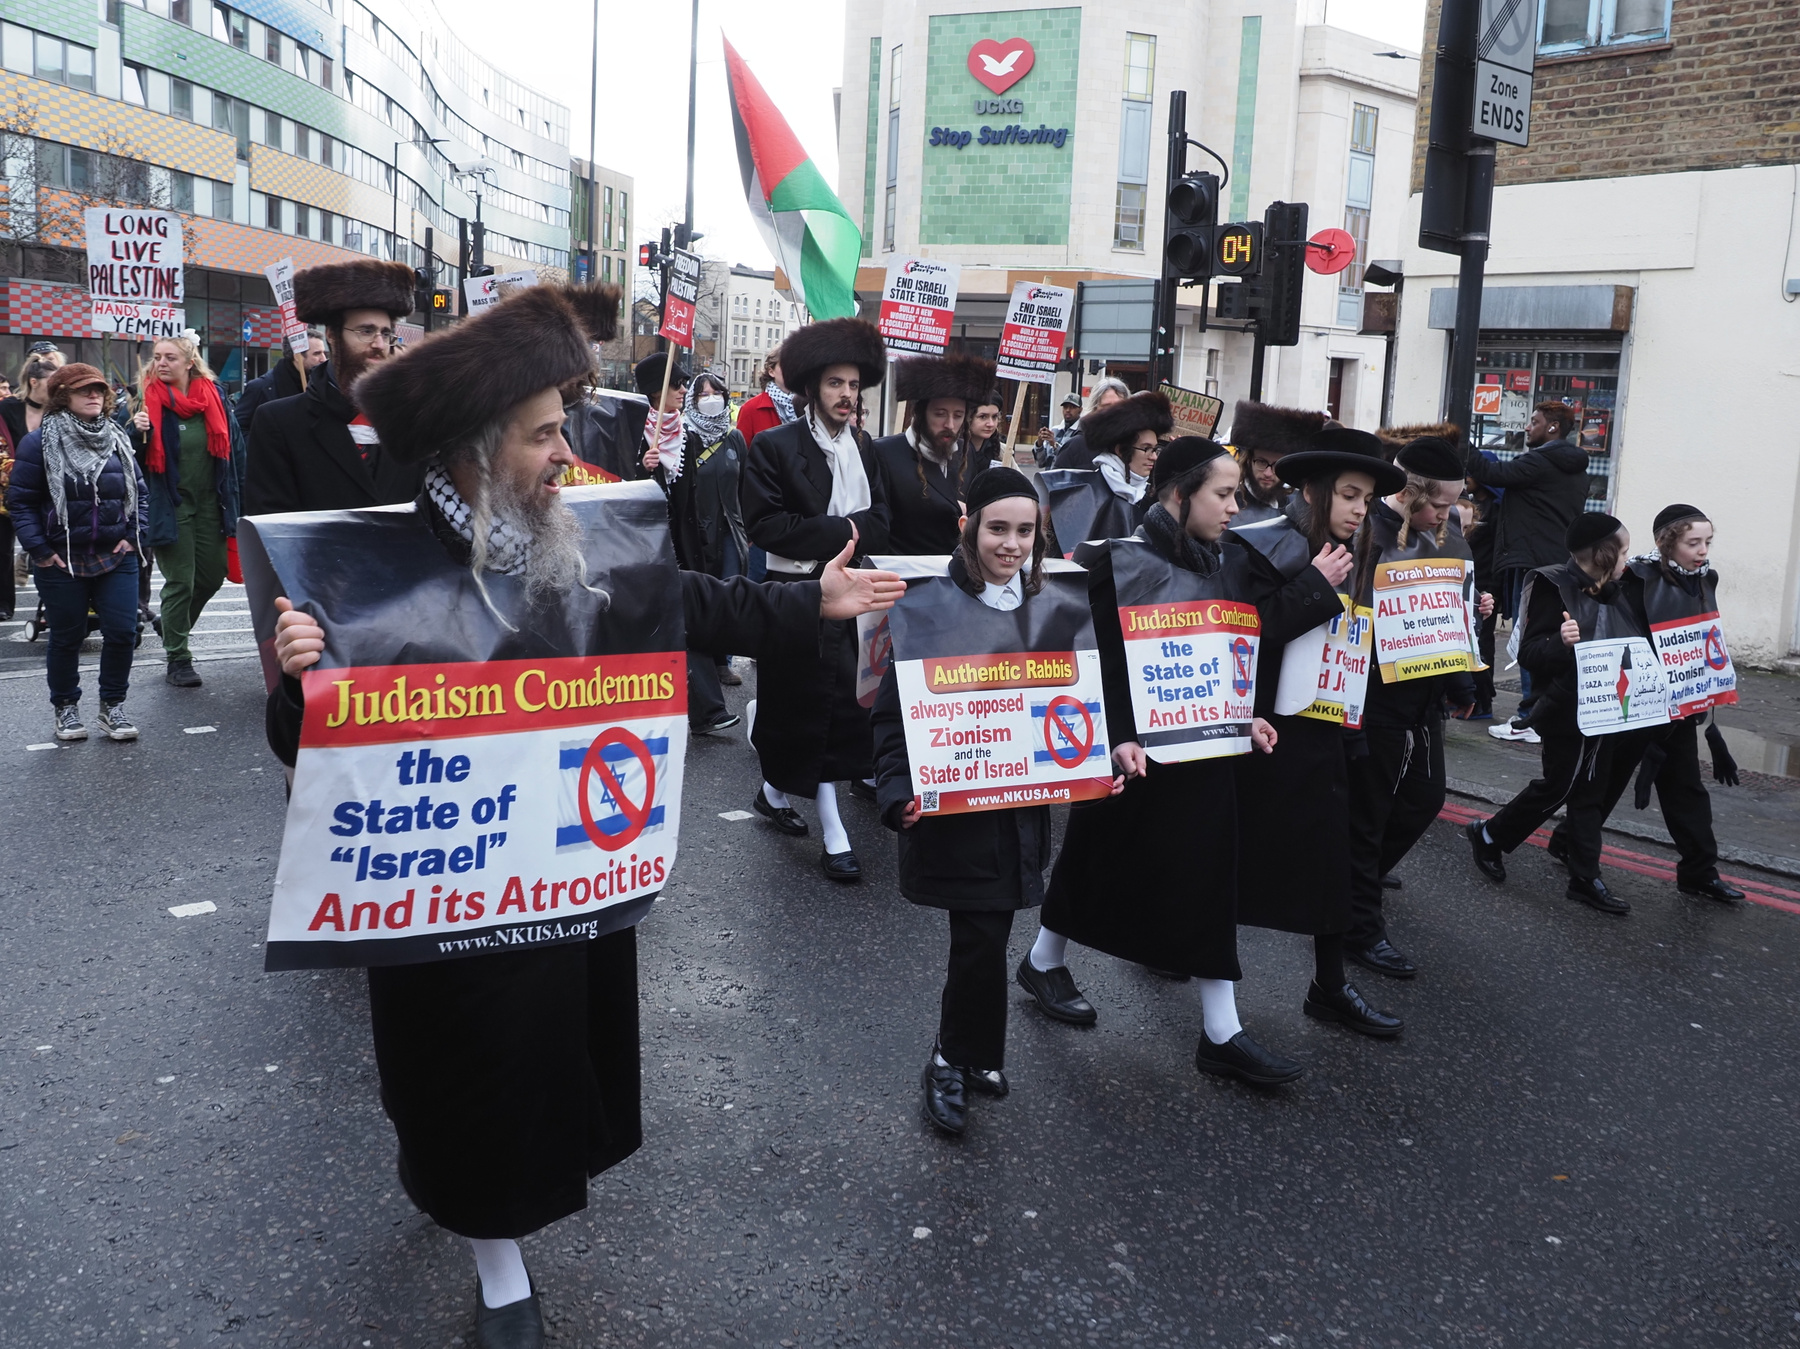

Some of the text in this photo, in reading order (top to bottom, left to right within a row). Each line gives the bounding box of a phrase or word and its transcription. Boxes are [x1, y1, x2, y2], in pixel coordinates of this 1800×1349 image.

[1491, 74, 1518, 99] Zone
[974, 98, 1024, 115] UCKG
[1481, 100, 1524, 133] ENDS
[929, 124, 1068, 150] Stop Suffering
[105, 213, 167, 238] LONG
[111, 240, 162, 263] LIVE
[1223, 235, 1251, 263] 04
[675, 254, 699, 277] FREEDOM
[914, 261, 946, 272] Socialist
[90, 264, 179, 300] PALESTINE
[670, 276, 697, 302] PALESTINE
[896, 277, 946, 295] END ISRAELI
[433, 295, 446, 308] 04
[472, 297, 488, 306] MASS
[890, 288, 949, 308] STATE TERROR
[1037, 289, 1063, 297] Socialist
[95, 301, 176, 320] HANDS OFF
[899, 304, 914, 314] BUILD
[921, 308, 933, 317] NEW
[1019, 302, 1061, 318] END ISRAELI
[113, 316, 180, 337] YEMEN!
[885, 319, 913, 330] SOCIALIST
[914, 322, 946, 335] ALTERNATIVE
[919, 316, 936, 326] PARTY
[1013, 312, 1063, 329] STATE TERROR
[881, 326, 945, 343] TO SUNAK AND STARMER
[1020, 328, 1034, 336] BUILD
[894, 339, 920, 350] SOCIALIST
[921, 343, 944, 355] INTIFADA
[1007, 340, 1031, 350] SOCIALIST
[999, 356, 1009, 364] FOR
[1009, 357, 1013, 365] A
[1014, 358, 1036, 368] SOCIALIST
[1181, 392, 1216, 413] MANY
[1476, 391, 1499, 410] 7UP
[1387, 567, 1423, 582] Torah
[1378, 597, 1406, 618] ALL
[1129, 604, 1258, 632] Judaism Condemns
[1403, 619, 1415, 630] be
[1418, 613, 1449, 627] returned
[1381, 633, 1436, 651] Palestinian
[1659, 630, 1702, 648] Judaism
[1161, 641, 1193, 658] the
[1662, 646, 1703, 666] Rejects
[934, 660, 1072, 686] Authentic Rabbis
[1142, 657, 1219, 681] State of
[1667, 666, 1705, 684] Zionism
[1585, 680, 1602, 689] GAZA
[326, 666, 674, 728] Judaism Condemns
[910, 693, 1024, 722] always opposed
[1149, 706, 1188, 727] And
[1192, 704, 1219, 722] its
[929, 725, 1012, 748] Zionism
[954, 747, 991, 760] and the
[396, 748, 471, 786] the
[920, 757, 1029, 785] State of Israel
[967, 787, 1070, 806] www.NKUSA.org
[329, 784, 517, 837] State of
[307, 854, 665, 932] And its Atrocities
[438, 919, 598, 954] www.NKUSA.org
